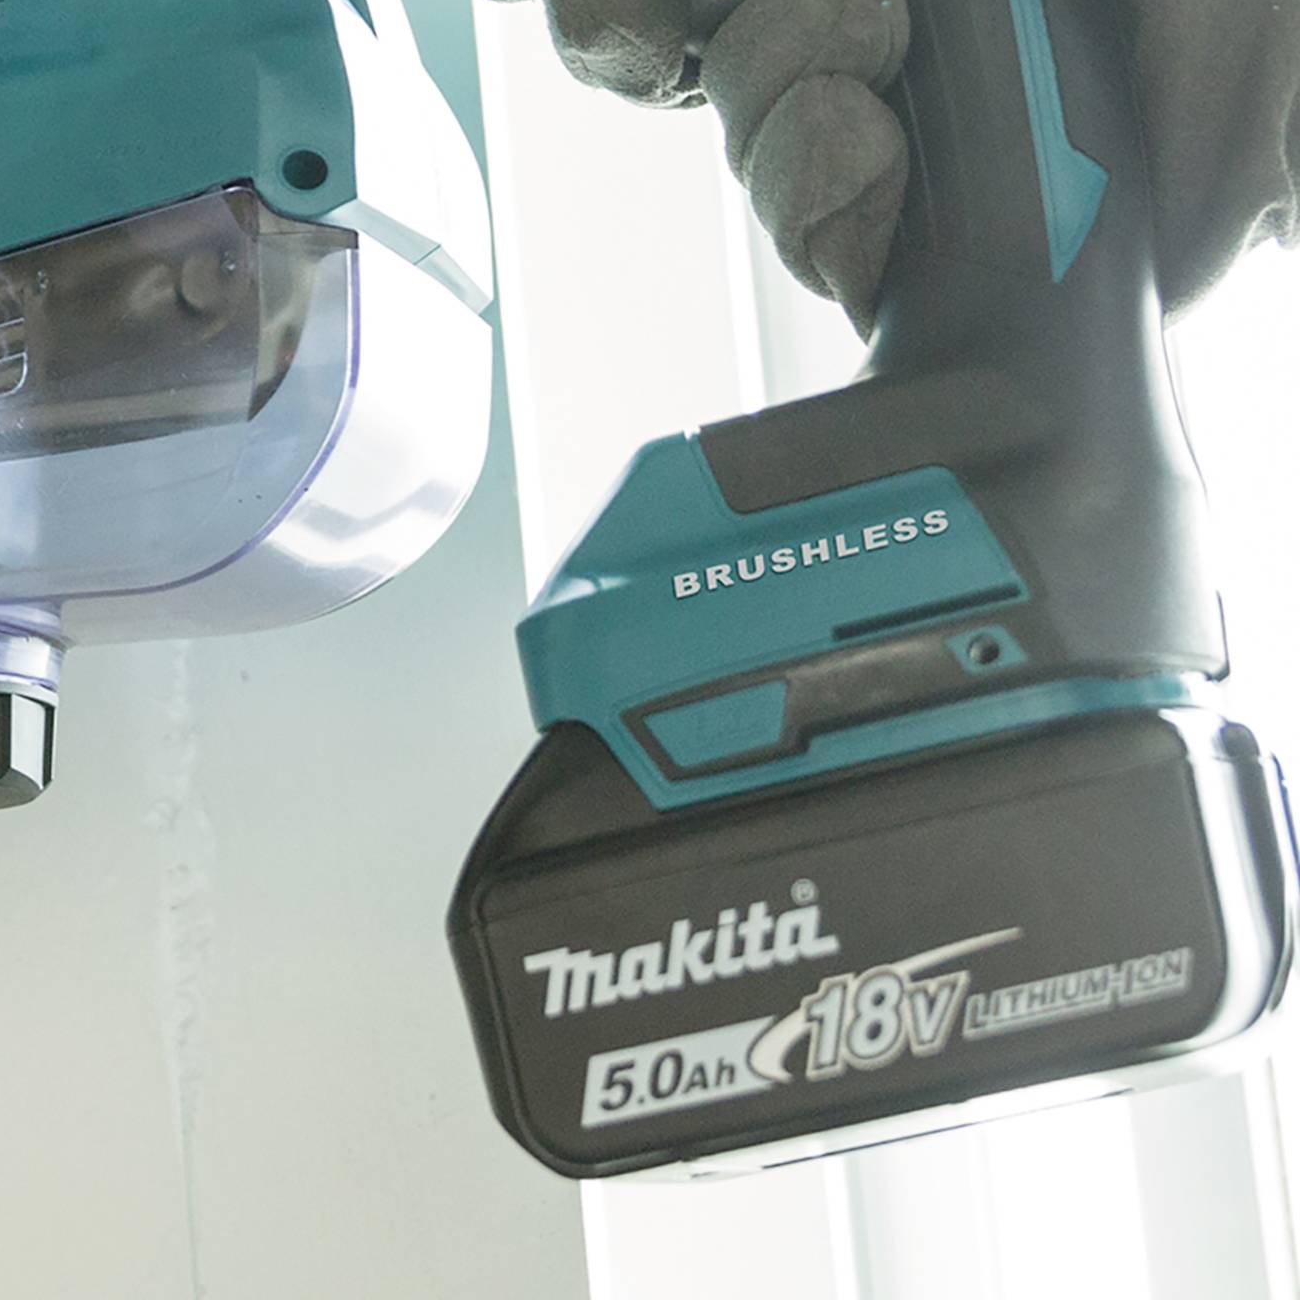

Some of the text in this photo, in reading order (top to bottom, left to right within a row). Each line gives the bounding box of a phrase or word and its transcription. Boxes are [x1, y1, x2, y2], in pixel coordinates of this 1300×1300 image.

[672, 508, 950, 599] BRUSHLESS
[599, 1048, 737, 1112] 5.0Ah
[962, 946, 1194, 1036] LITHIUM-ION
